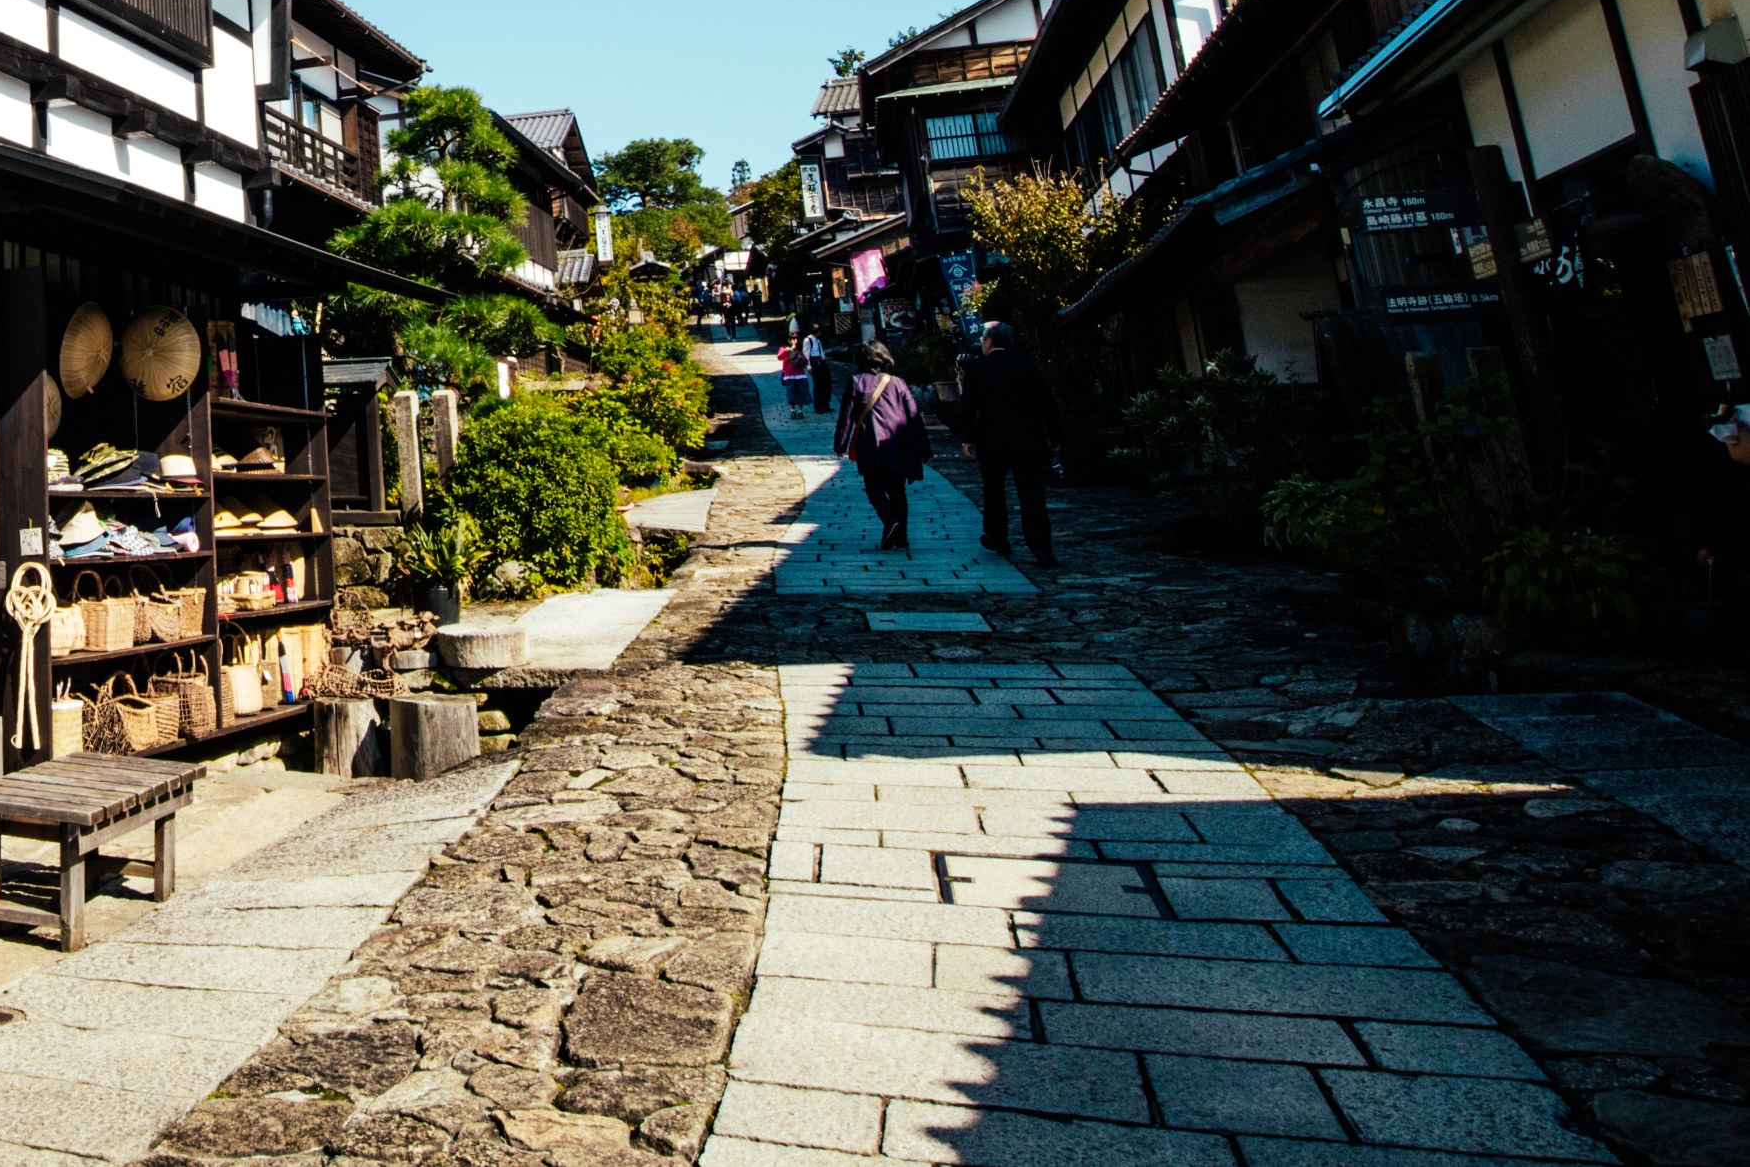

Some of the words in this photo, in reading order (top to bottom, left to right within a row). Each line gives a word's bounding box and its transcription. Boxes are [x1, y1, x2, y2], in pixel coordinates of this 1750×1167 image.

[1362, 197, 1398, 208] 永昌寺
[1402, 197, 1426, 206] 160m
[1366, 211, 1428, 226] 島崎藤村墓
[1430, 212, 1455, 221] 180m
[1471, 293, 1499, 303] 0.5km
